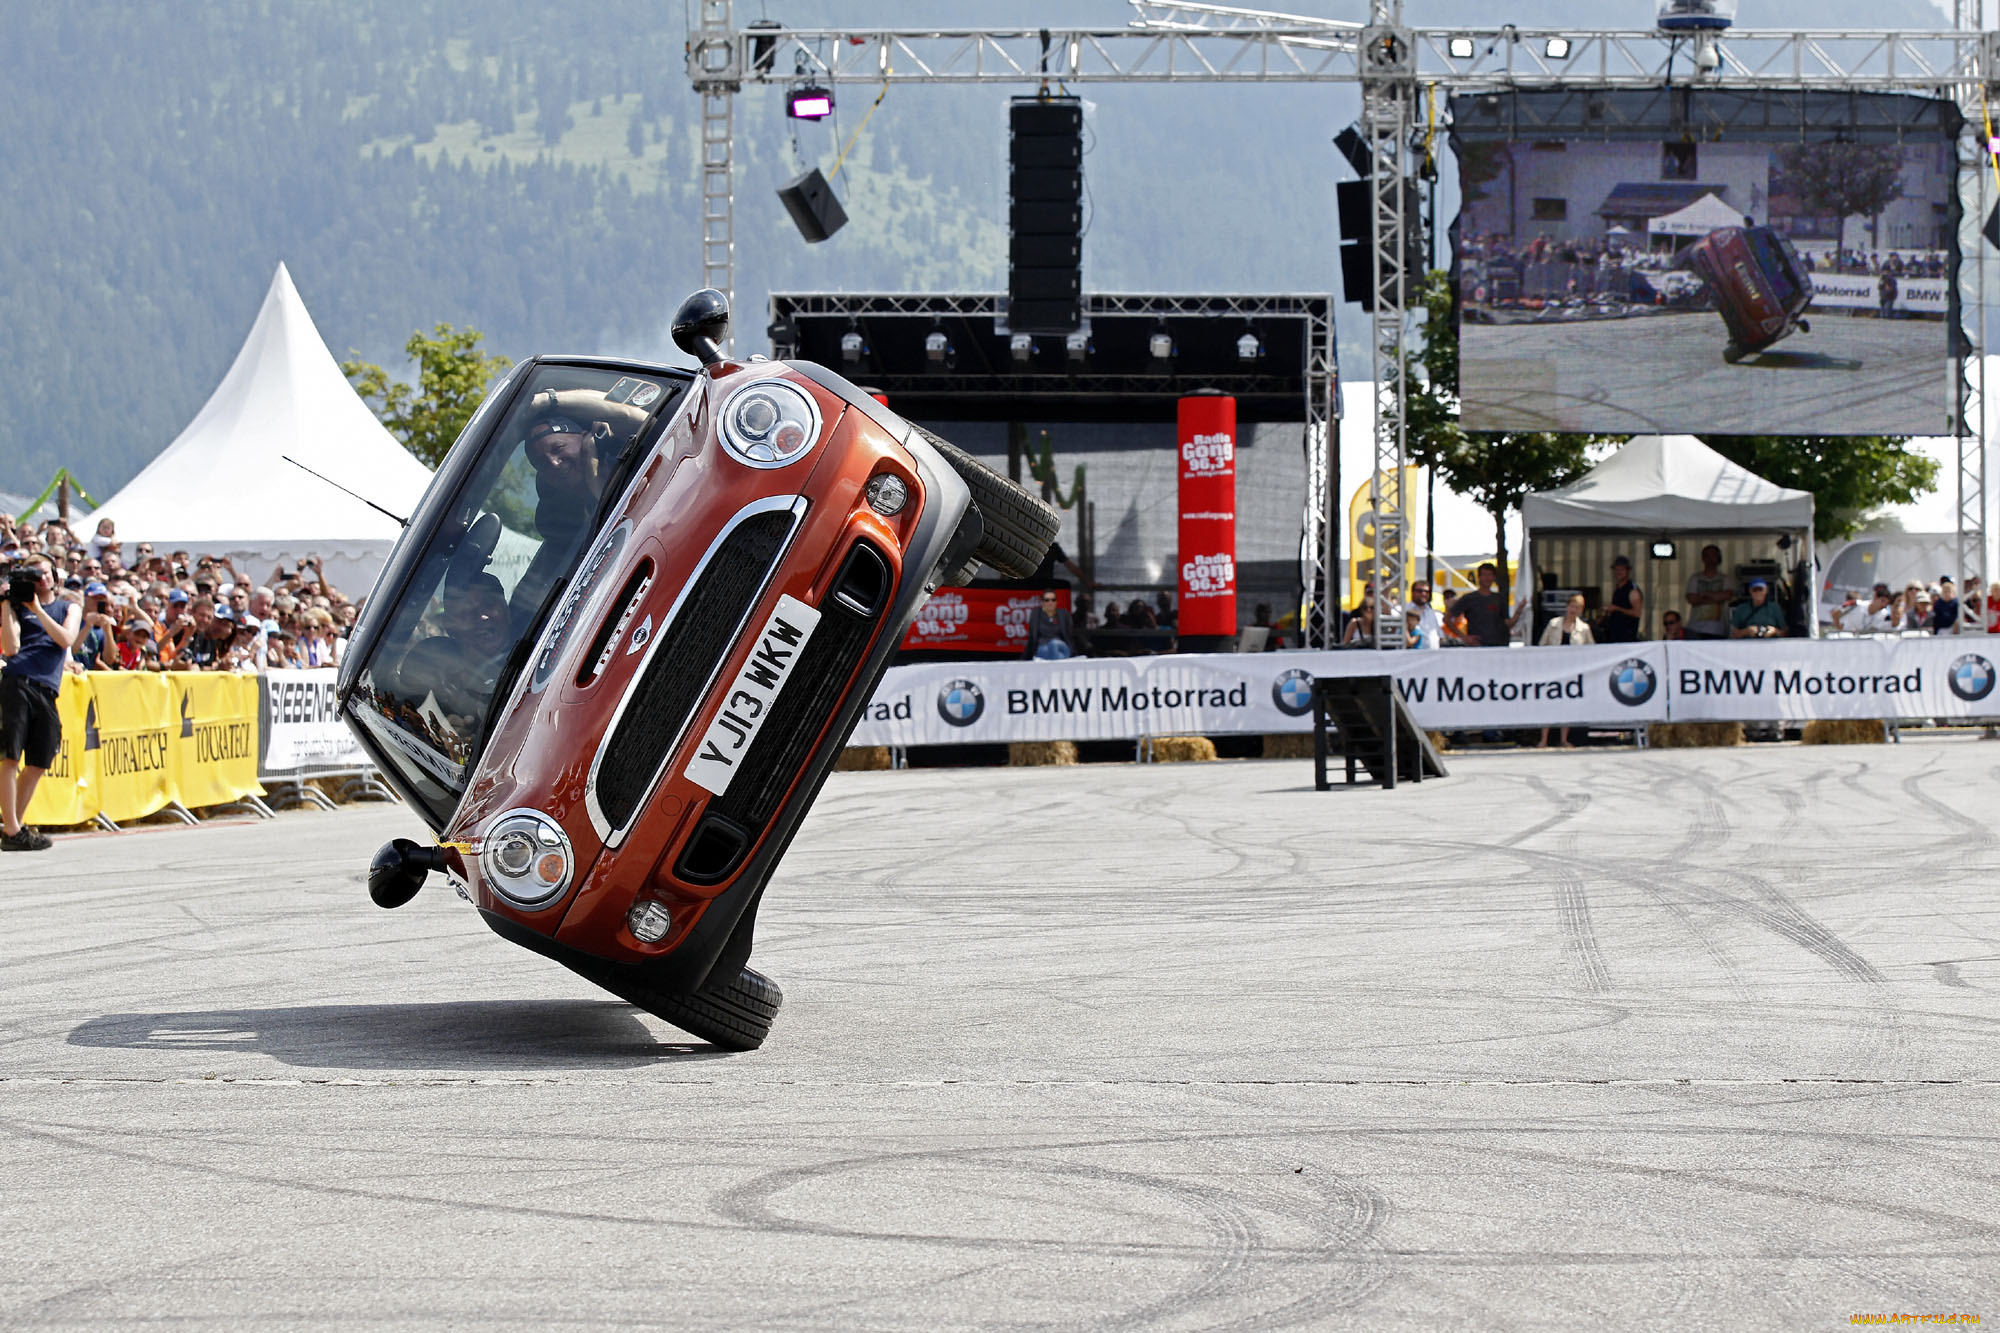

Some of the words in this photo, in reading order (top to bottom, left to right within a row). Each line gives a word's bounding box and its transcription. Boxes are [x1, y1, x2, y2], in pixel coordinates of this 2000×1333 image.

[1814, 285, 1871, 298] Motorrad
[1906, 288, 1941, 301] BMW
[1194, 432, 1231, 445] Radio
[1182, 442, 1233, 461] Gong
[1189, 456, 1226, 472] 96,3
[1194, 552, 1232, 565] Radio
[1182, 562, 1234, 582] Gong
[1189, 577, 1226, 592] 96,3
[917, 618, 956, 636] 96,3
[1437, 674, 1583, 702] Motorrad
[1680, 669, 1765, 695] BMW
[1774, 668, 1922, 695] Motorrad
[699, 690, 763, 767] YJ13
[744, 616, 804, 691] WKW
[1007, 688, 1092, 714] BMW
[1101, 682, 1247, 711] Motorrad
[271, 682, 342, 724] SIEBENR
[101, 731, 169, 777] TOURATECH
